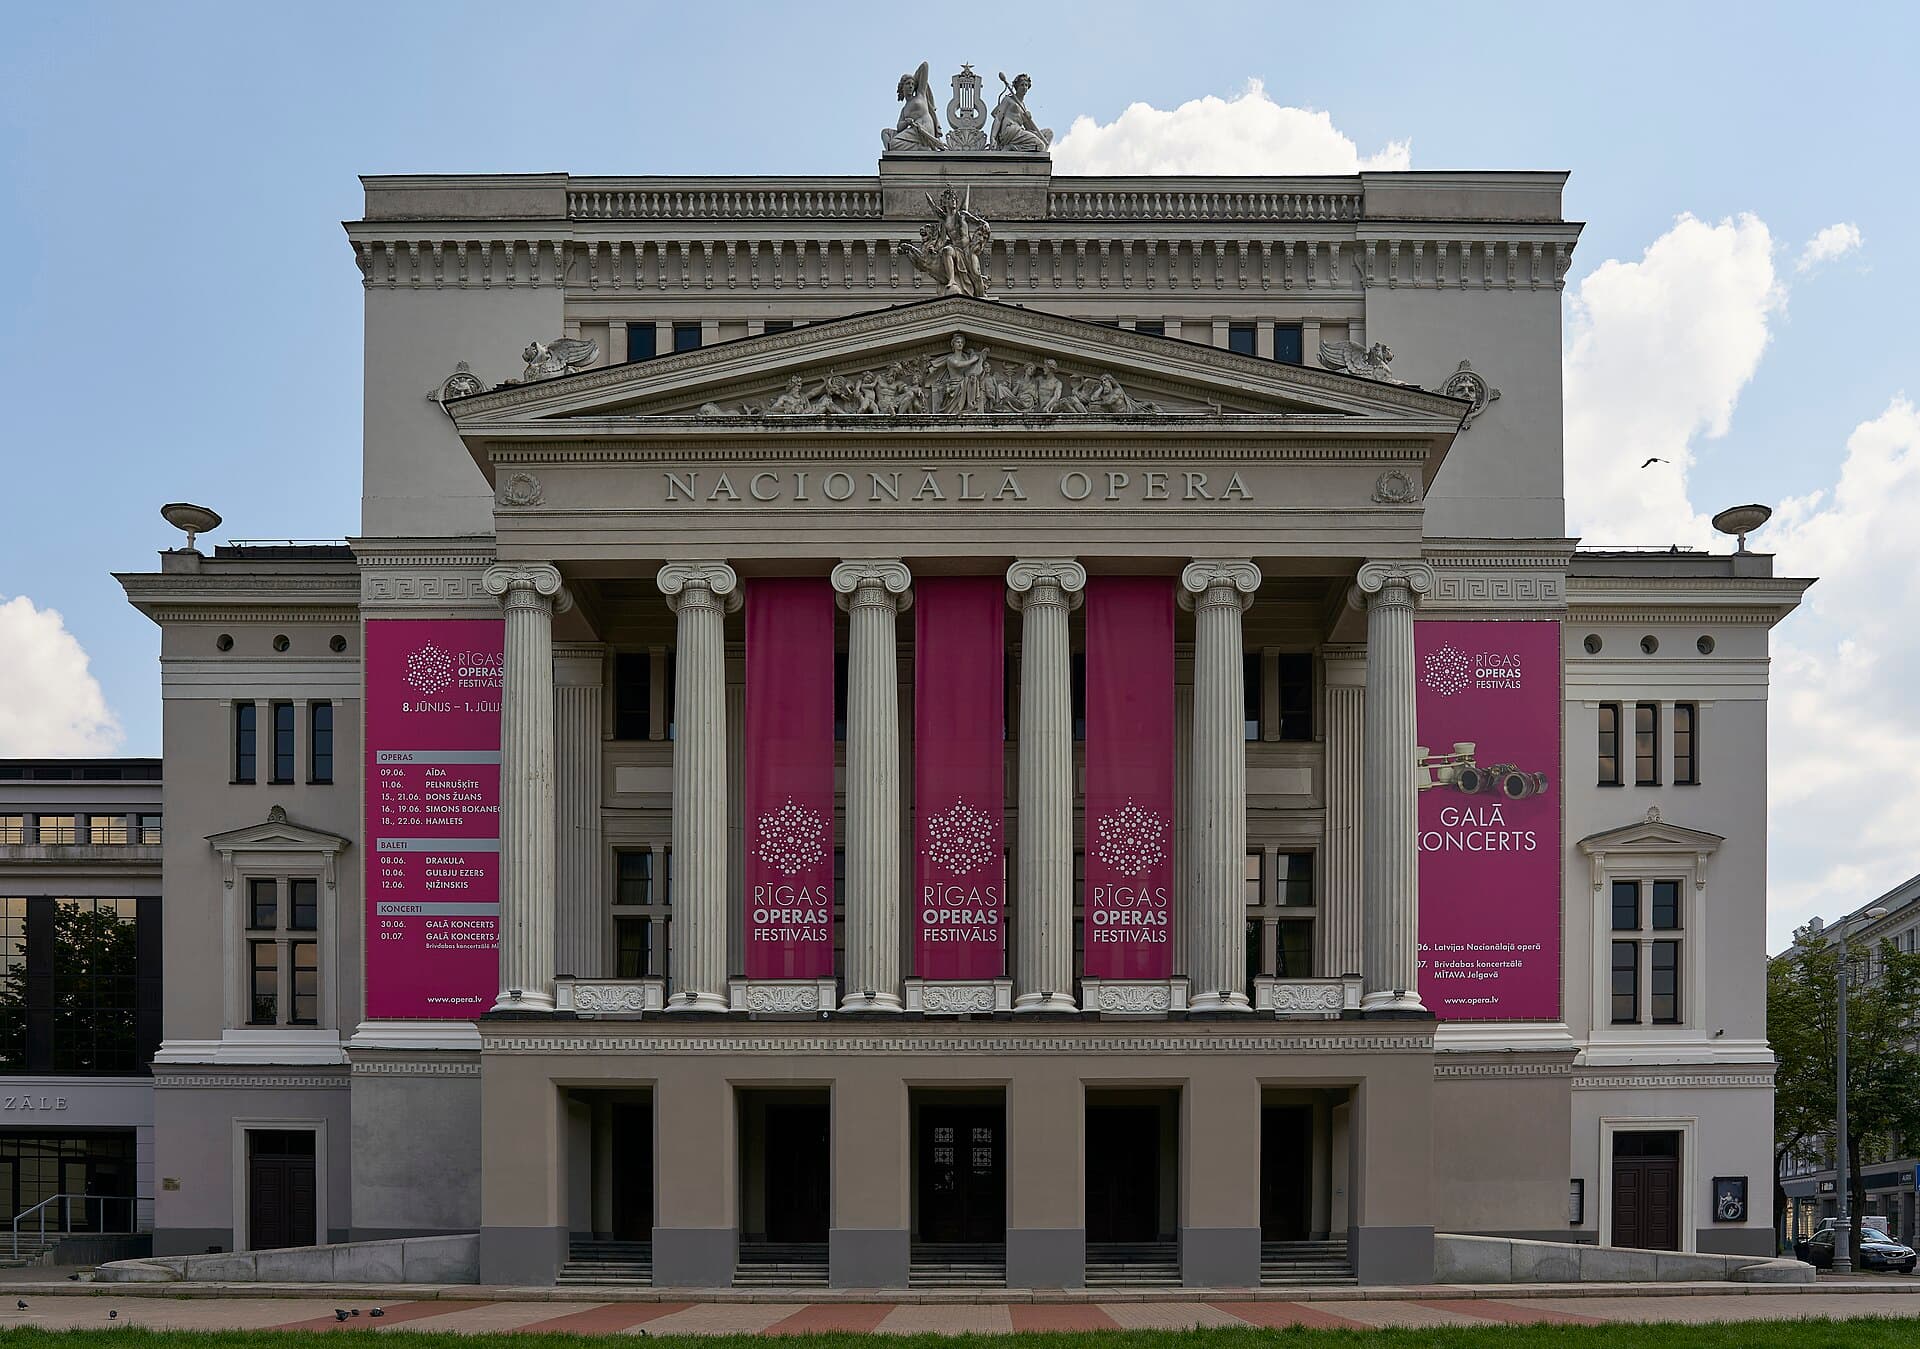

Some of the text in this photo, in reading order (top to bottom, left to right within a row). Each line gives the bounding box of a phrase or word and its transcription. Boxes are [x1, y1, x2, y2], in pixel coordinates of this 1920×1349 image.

[664, 467, 1254, 501] NACIONĀLĀ OPERA
[459, 651, 503, 665] RĪGAS
[1476, 652, 1520, 667] RĪGAS
[459, 668, 503, 677] OPERAS
[1476, 669, 1521, 678] OPERAS
[459, 678, 503, 688] FESTIVĀLS
[1477, 679, 1520, 688] FESTIVĀLS
[403, 703, 412, 712] 8.
[415, 701, 450, 712] JŪNIJS
[465, 703, 473, 712] 1.
[381, 753, 413, 761] OPERAS
[381, 768, 446, 777] 09.06. AĪDA
[382, 779, 479, 790] 11.06. PELNRUŠĶĪTE
[398, 793, 421, 801] 21.06.
[426, 793, 450, 801] DONS
[453, 792, 481, 801] ŽUANS
[399, 805, 421, 813] 19.06.
[426, 805, 459, 813] SIMONS
[1441, 804, 1505, 826] GALĀ
[398, 817, 422, 825] 22.06.
[426, 817, 462, 825] HAMLETS
[381, 841, 407, 849] BALETI
[381, 857, 464, 865] 08.06. DRAKULA
[382, 869, 483, 877] 10.06. GULBJU EZERS
[383, 881, 404, 889] 12.06.
[755, 883, 827, 905] RĪGAS
[925, 883, 996, 906] RĪGAS
[1095, 884, 1166, 907] RĪGAS
[381, 905, 421, 913] KONCERTI
[753, 909, 828, 924] OPERAS
[923, 909, 997, 924] OPERAS
[1093, 910, 1167, 925] OPERAS
[381, 920, 494, 929] 30.06. GALĀ KONCERTS
[381, 932, 403, 940] 01.07.
[426, 932, 449, 941] GALĀ
[451, 933, 494, 941] KONCERTS
[755, 926, 827, 941] FESTIVĀLS
[924, 926, 997, 941] FESTIVĀLS
[1094, 927, 1167, 942] FESTIVĀLS
[1435, 944, 1464, 953] Latvijas
[1435, 970, 1465, 979] MĪTAVA
[428, 996, 482, 1005] www.opera.lv
[1445, 996, 1498, 1005] www.opera.lv
[4, 1094, 68, 1110] ZĀLE
